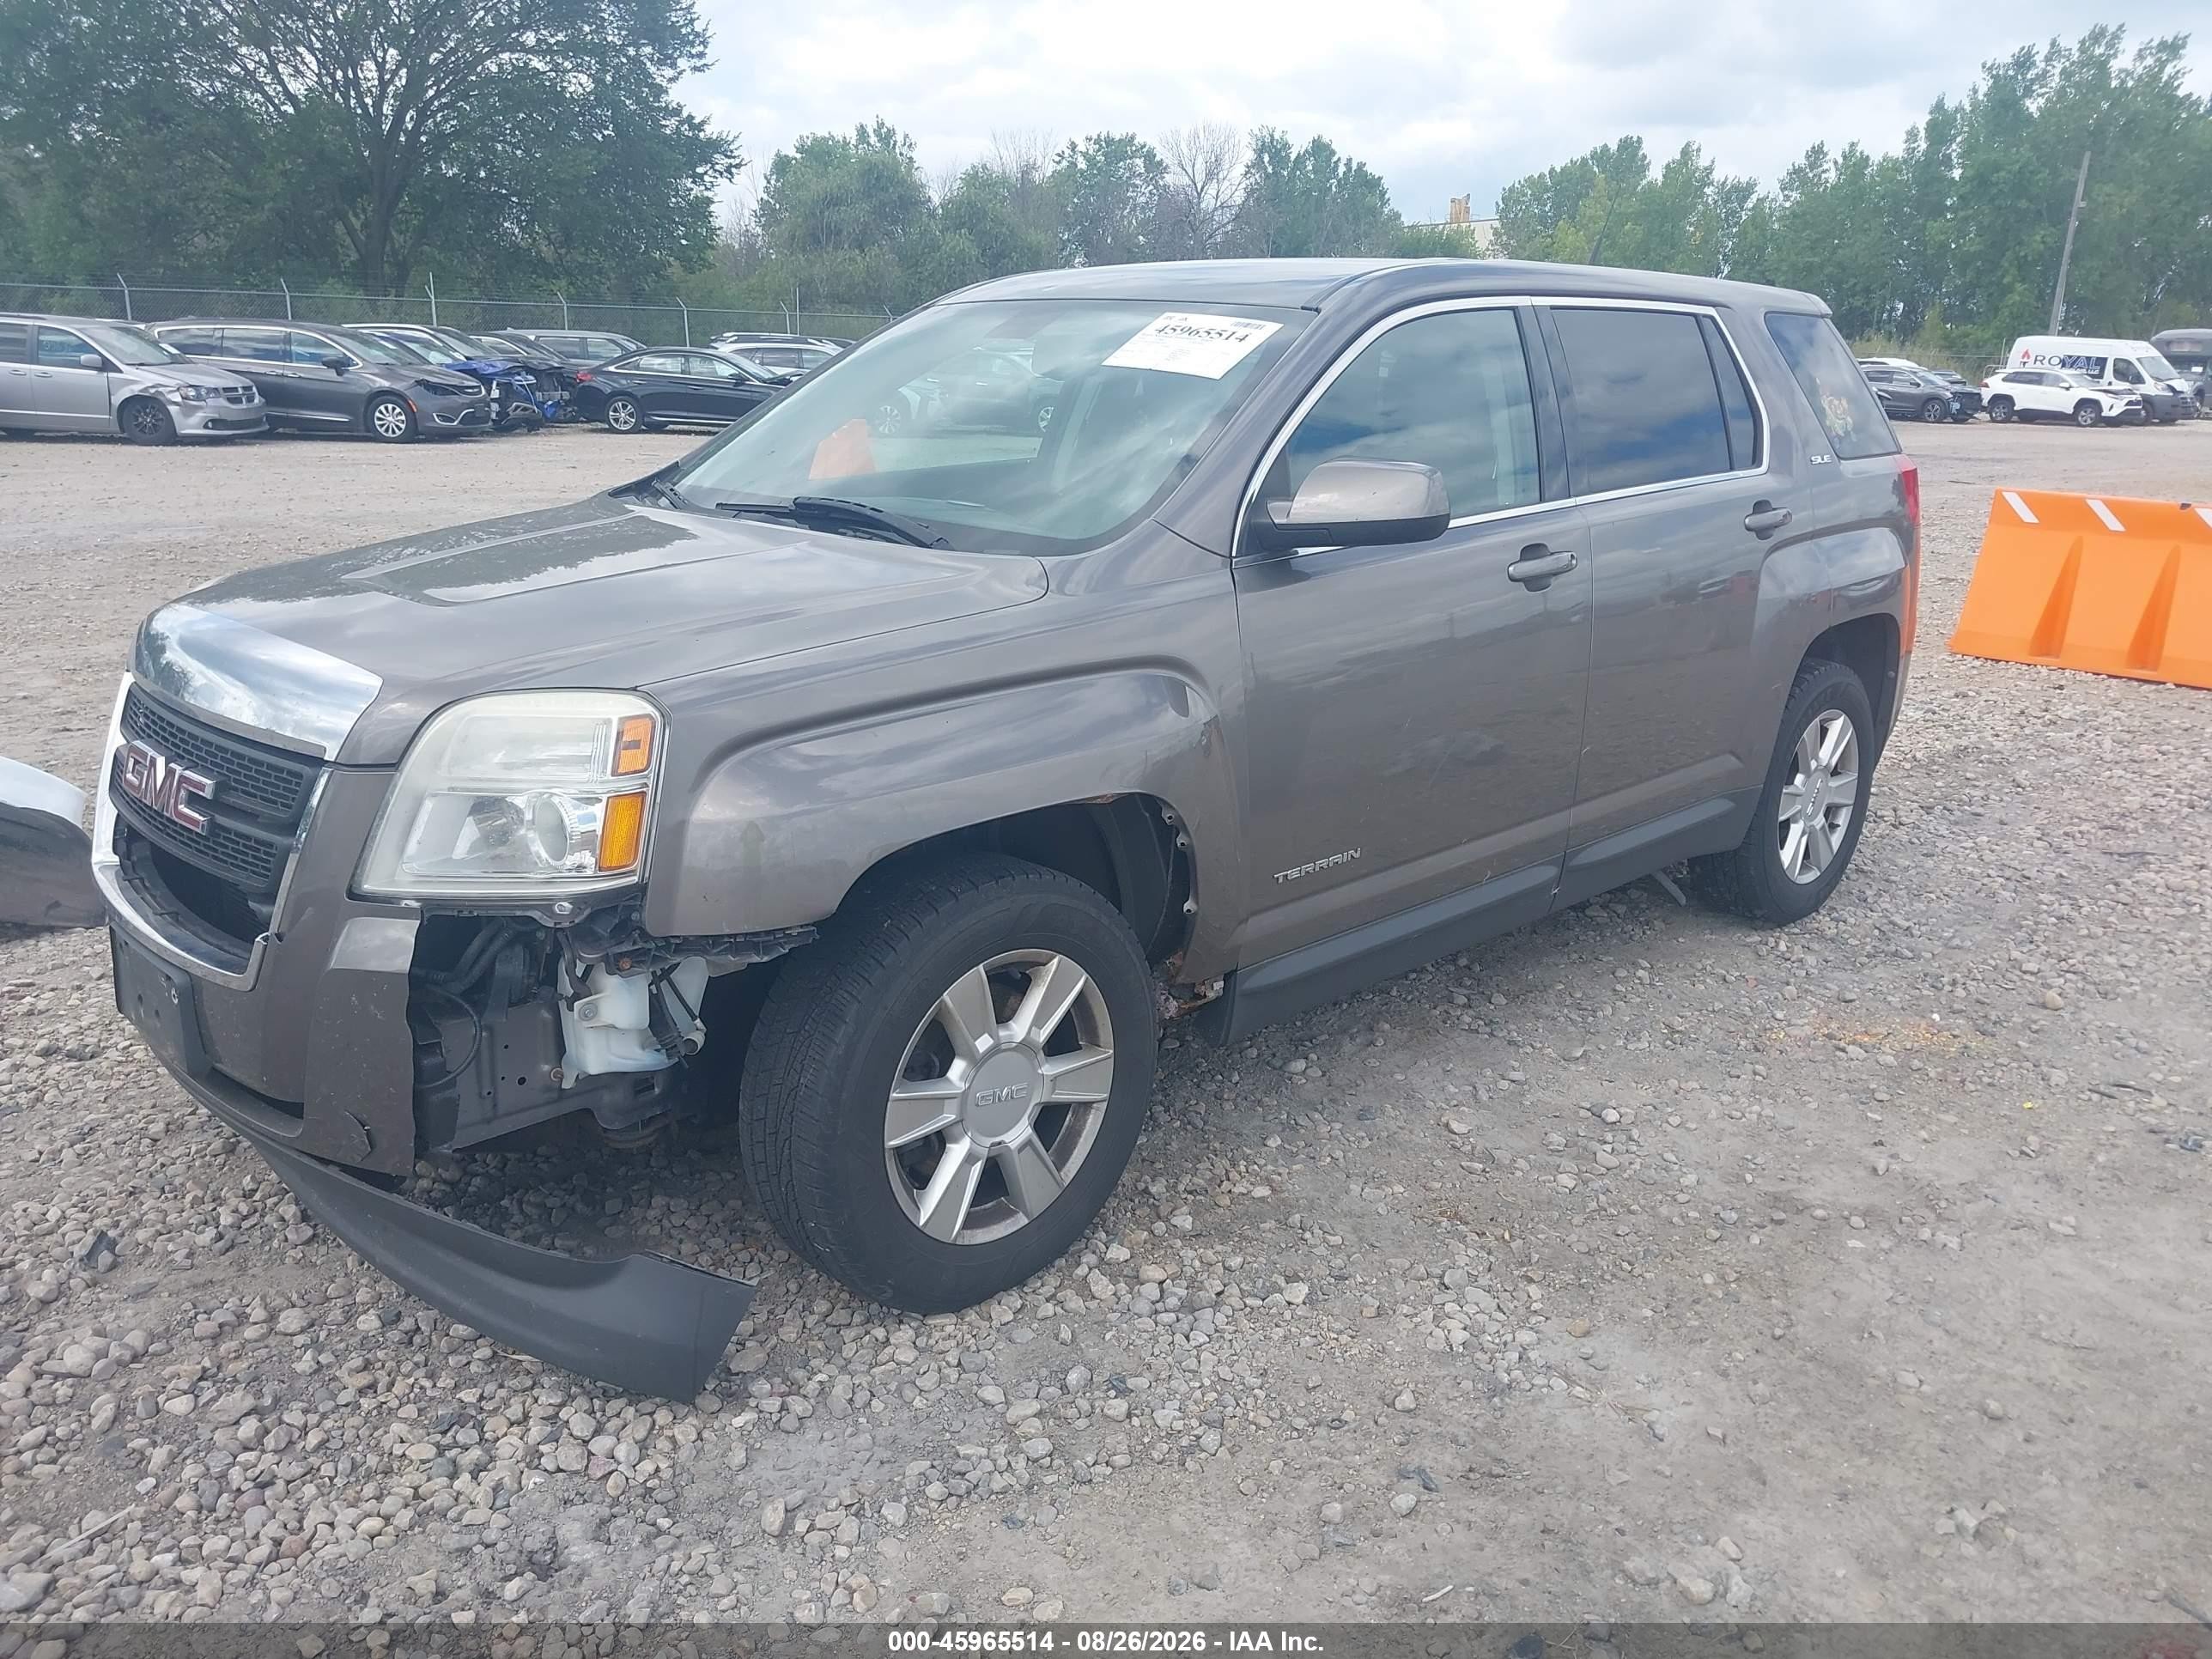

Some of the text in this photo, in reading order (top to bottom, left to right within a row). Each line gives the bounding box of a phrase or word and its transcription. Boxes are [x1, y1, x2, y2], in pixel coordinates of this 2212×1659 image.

[1155, 325, 1250, 342] 45965514
[2033, 355, 2100, 369] ROYAL
[1810, 455, 1832, 465] SLE
[123, 740, 216, 835] GMC
[1273, 848, 1361, 884] TERRAIN
[975, 1083, 1029, 1107] GMC
